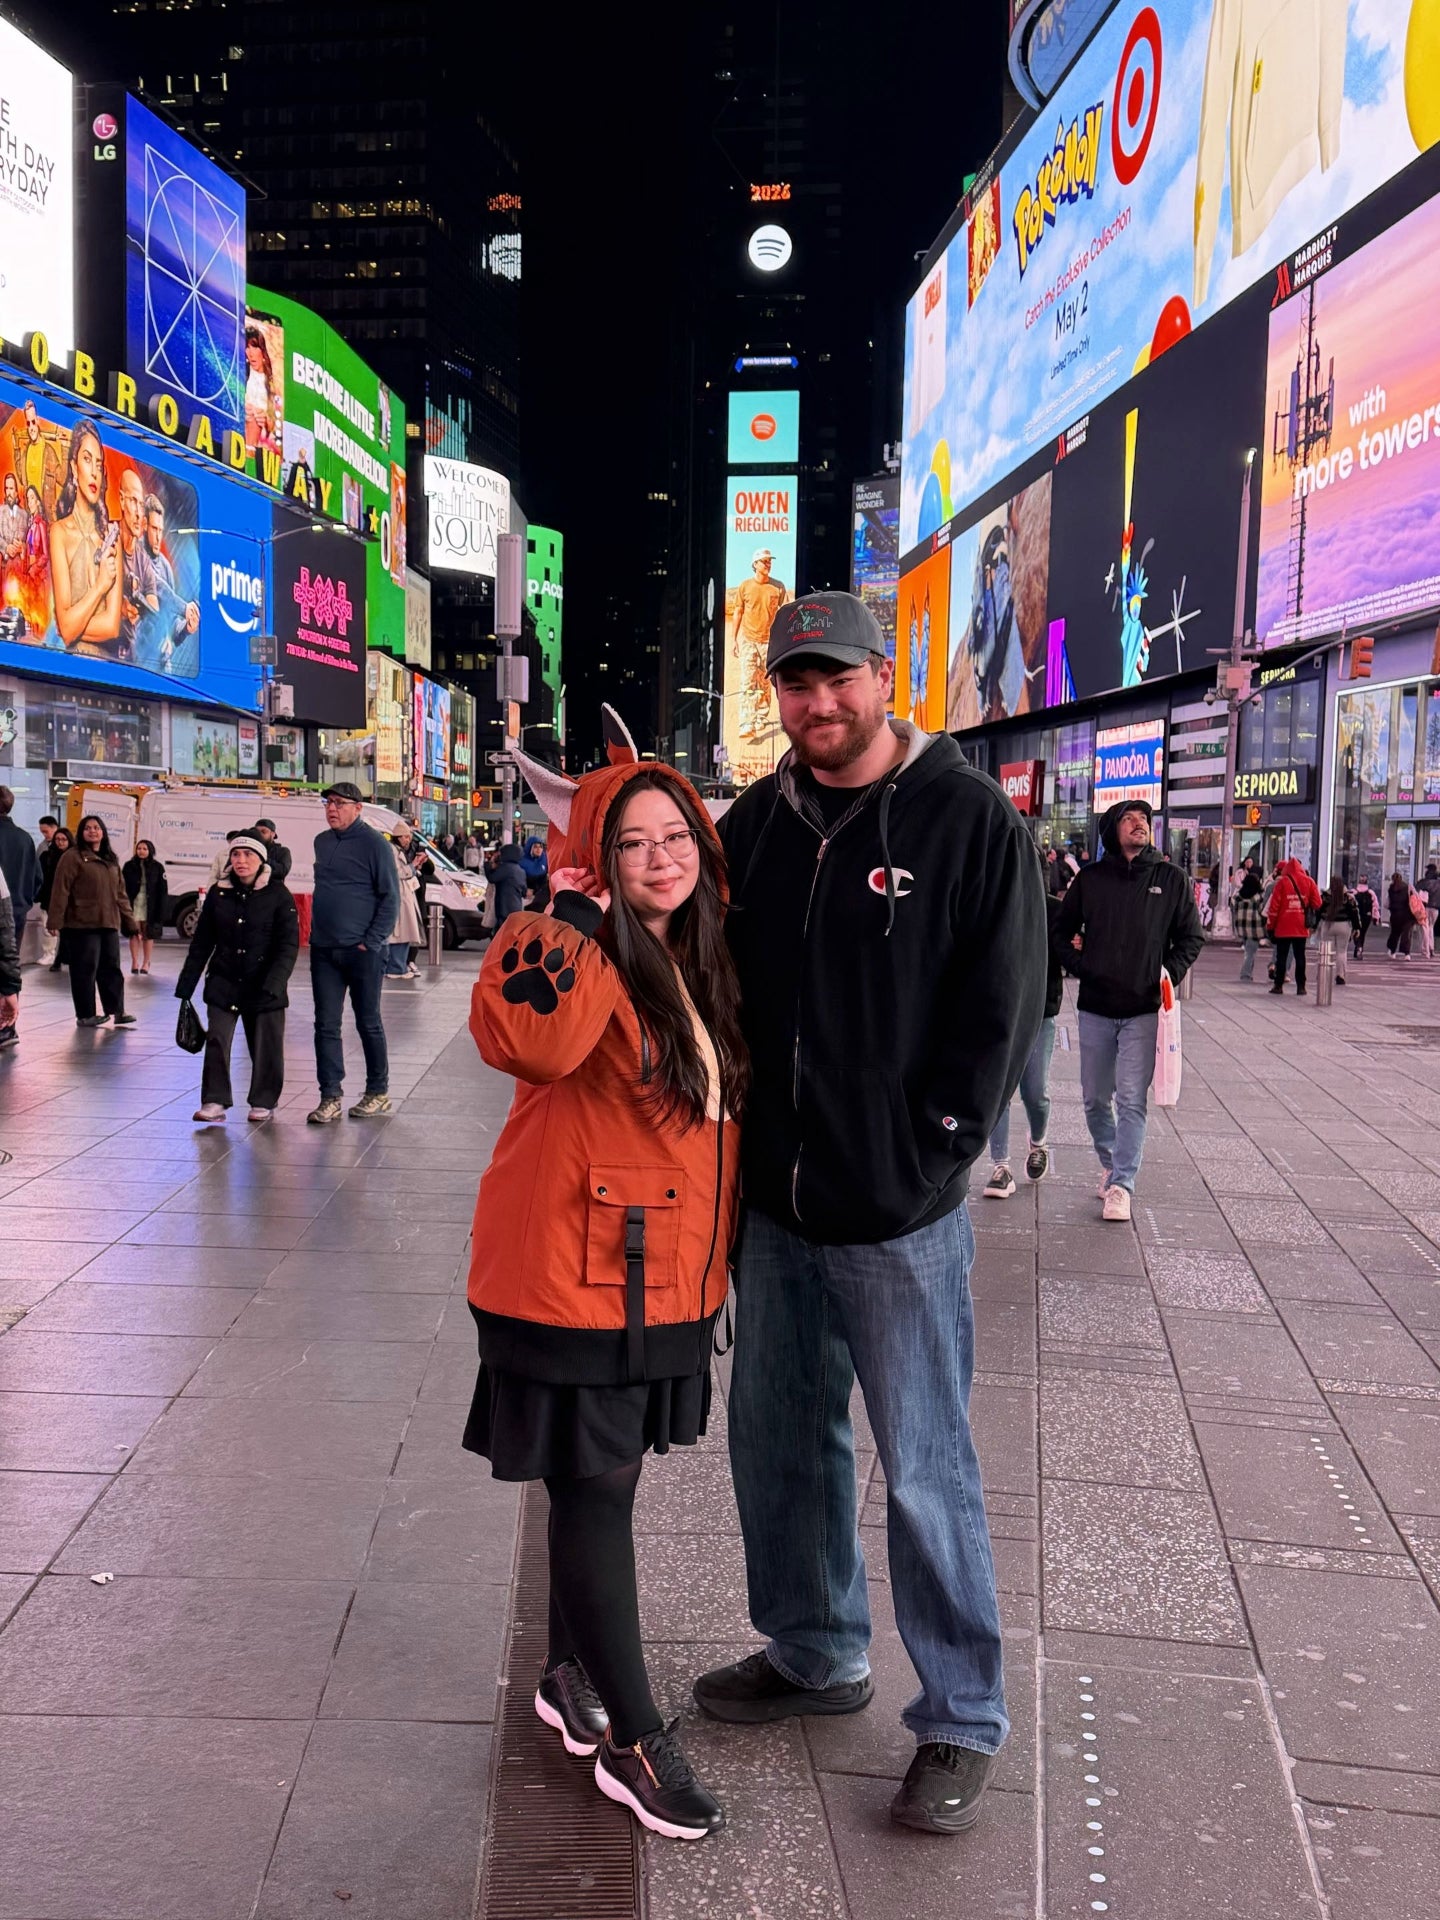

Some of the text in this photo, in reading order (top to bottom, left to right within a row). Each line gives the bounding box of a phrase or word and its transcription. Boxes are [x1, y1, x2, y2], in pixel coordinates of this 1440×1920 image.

[24, 143, 55, 183] DAY
[93, 144, 117, 161] LG
[750, 183, 791, 201] 2026
[1056, 251, 1088, 298] Exclusive
[1090, 205, 1131, 261] Collection
[1294, 225, 1339, 269] MARRIOTT
[1293, 248, 1332, 287] MARQUIS
[1056, 279, 1089, 341] May 2
[1050, 354, 1067, 380] Limited
[1078, 334, 1090, 358] Only
[292, 352, 343, 412] BECOME
[349, 396, 375, 442] LITTLE
[1349, 383, 1386, 428] with
[75, 349, 332, 512] BROADWAY
[313, 409, 344, 458] MORE
[433, 461, 499, 493] WELCOME
[1294, 446, 1354, 500] more
[735, 491, 789, 515] OWEN
[855, 498, 885, 510] WONDER
[856, 490, 883, 501] IMAGINE
[735, 516, 789, 533] RIEGLING
[211, 559, 263, 607] prime
[1260, 666, 1296, 685] SEPHORA
[1105, 752, 1150, 780] PANDORA
[1195, 744, 1204, 753] W
[1205, 744, 1217, 754] 46
[1234, 770, 1298, 799] SEPHORA
